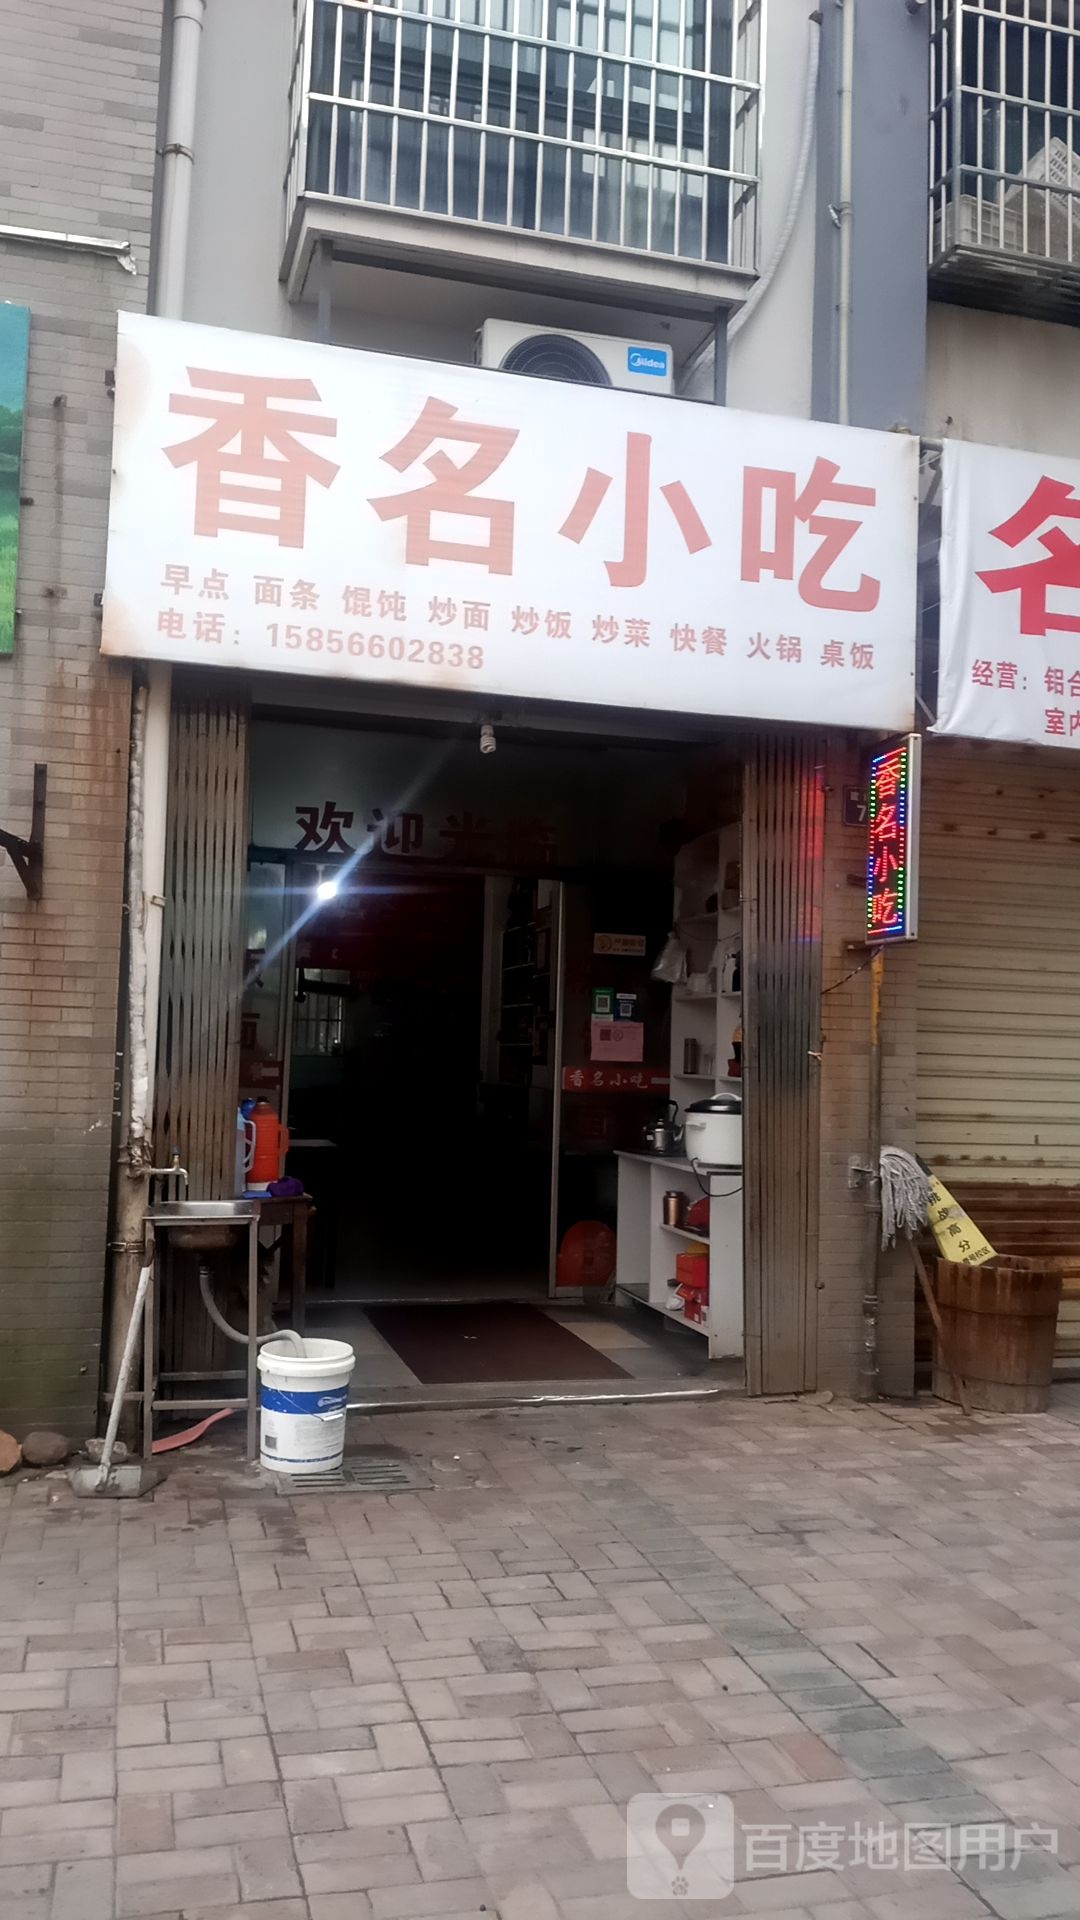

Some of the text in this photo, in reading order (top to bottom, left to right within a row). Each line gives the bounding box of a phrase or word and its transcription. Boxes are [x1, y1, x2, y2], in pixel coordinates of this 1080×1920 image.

[630, 353, 665, 369] Midea
[161, 365, 881, 612] 香名小吃
[974, 474, 1080, 637] 名
[157, 607, 485, 670] 电话： 15856602838
[160, 564, 874, 670] 早点 面条 馄饨 炒面 炒饭 炒菜 快餐 火锅 桌饭
[874, 757, 901, 924] 香名小吃
[568, 1069, 648, 1089] 香名小吃
